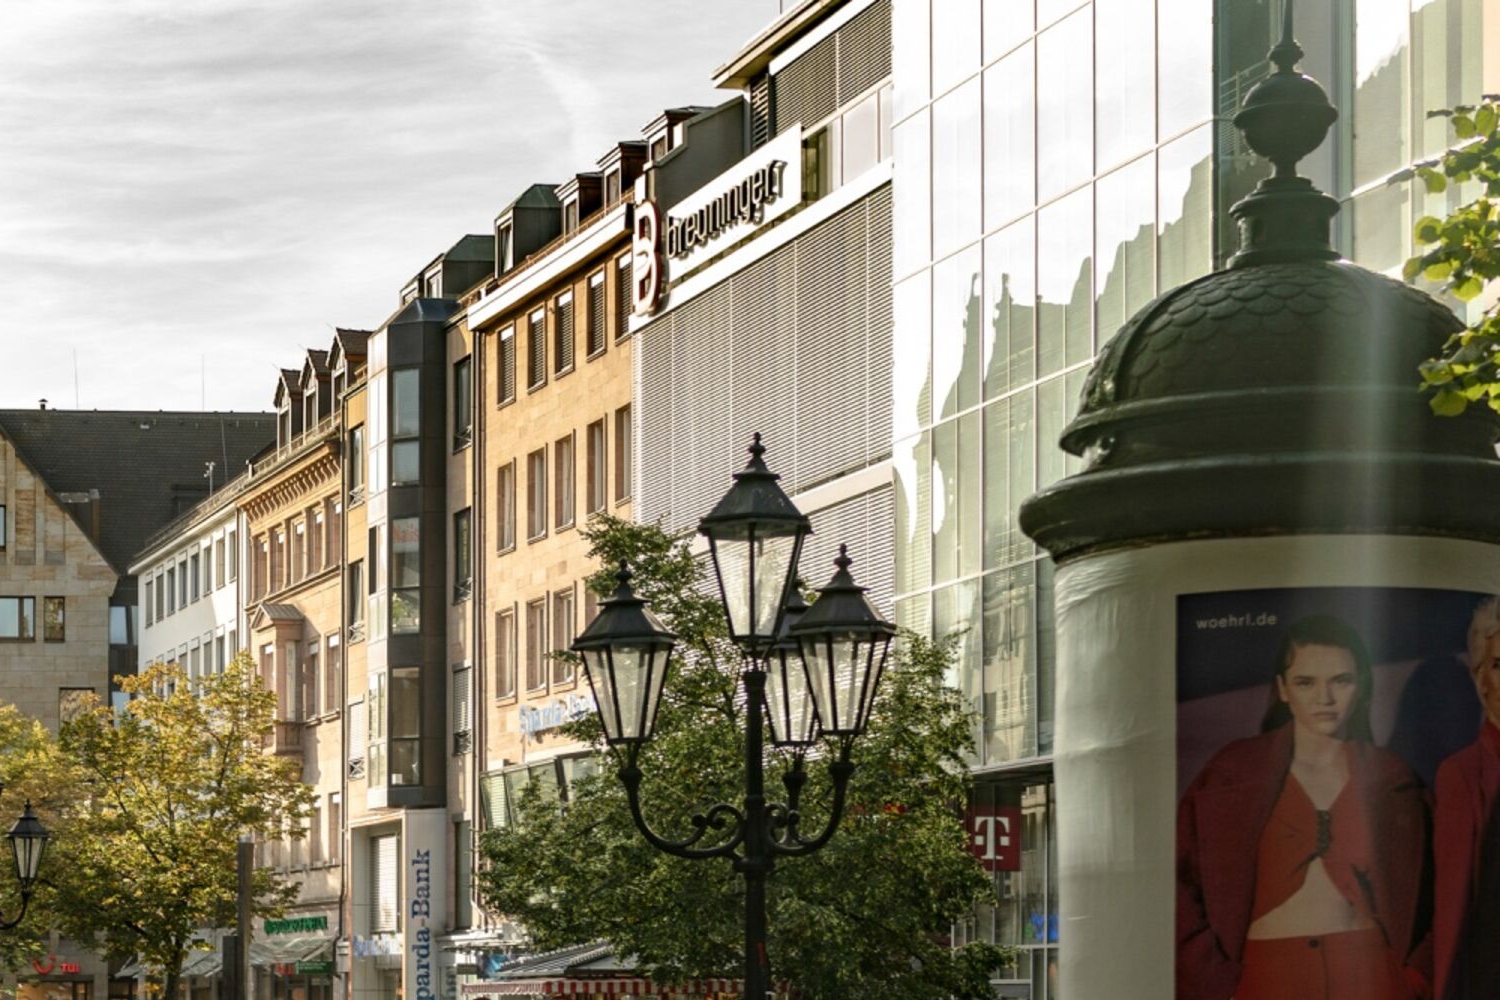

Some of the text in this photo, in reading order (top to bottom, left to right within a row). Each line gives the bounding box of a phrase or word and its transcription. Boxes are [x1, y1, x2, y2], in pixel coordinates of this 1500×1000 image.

[666, 158, 788, 260] breuninger
[1196, 612, 1277, 629] woehrl.de
[974, 816, 1011, 860] T
[60, 962, 81, 974] TUI
